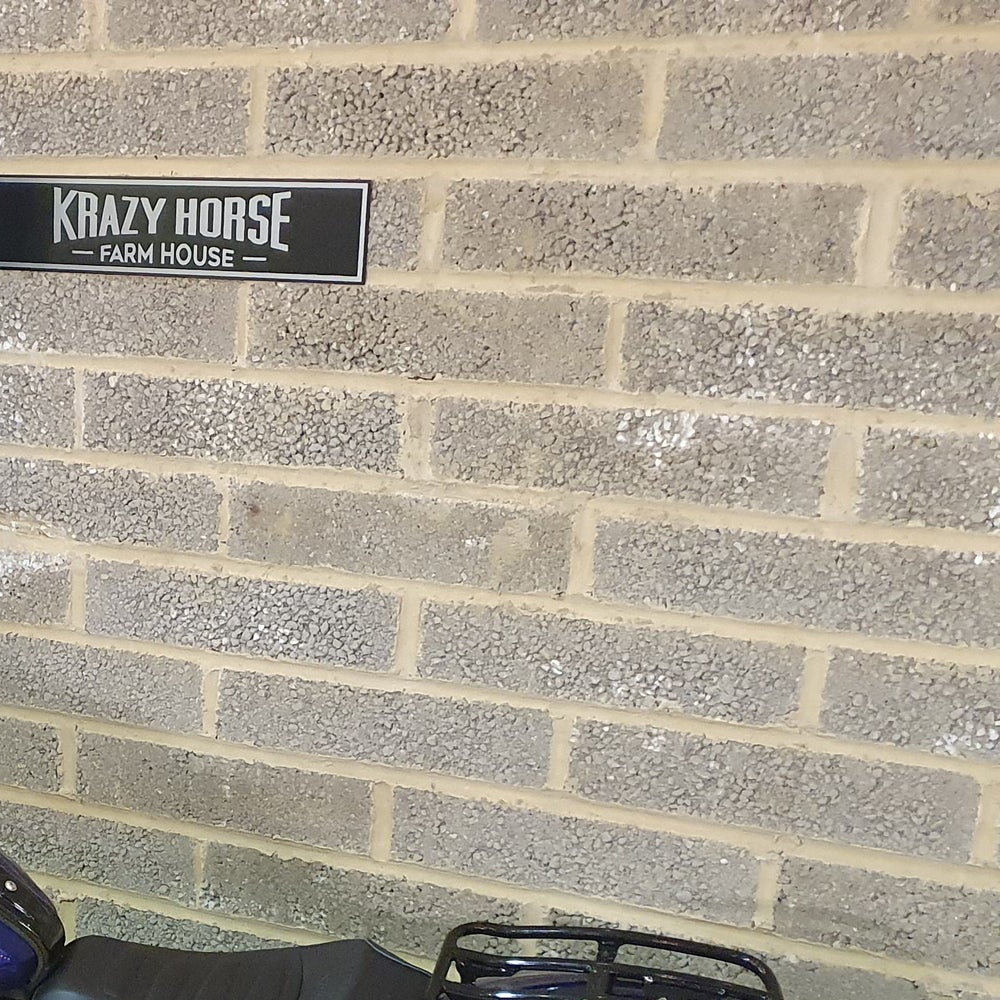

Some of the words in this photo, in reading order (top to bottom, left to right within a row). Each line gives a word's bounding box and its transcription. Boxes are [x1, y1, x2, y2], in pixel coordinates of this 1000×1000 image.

[53, 186, 167, 244] KRAZY
[175, 190, 292, 252] HORSE
[100, 242, 154, 265] FARM
[161, 243, 234, 267] HOUSE
